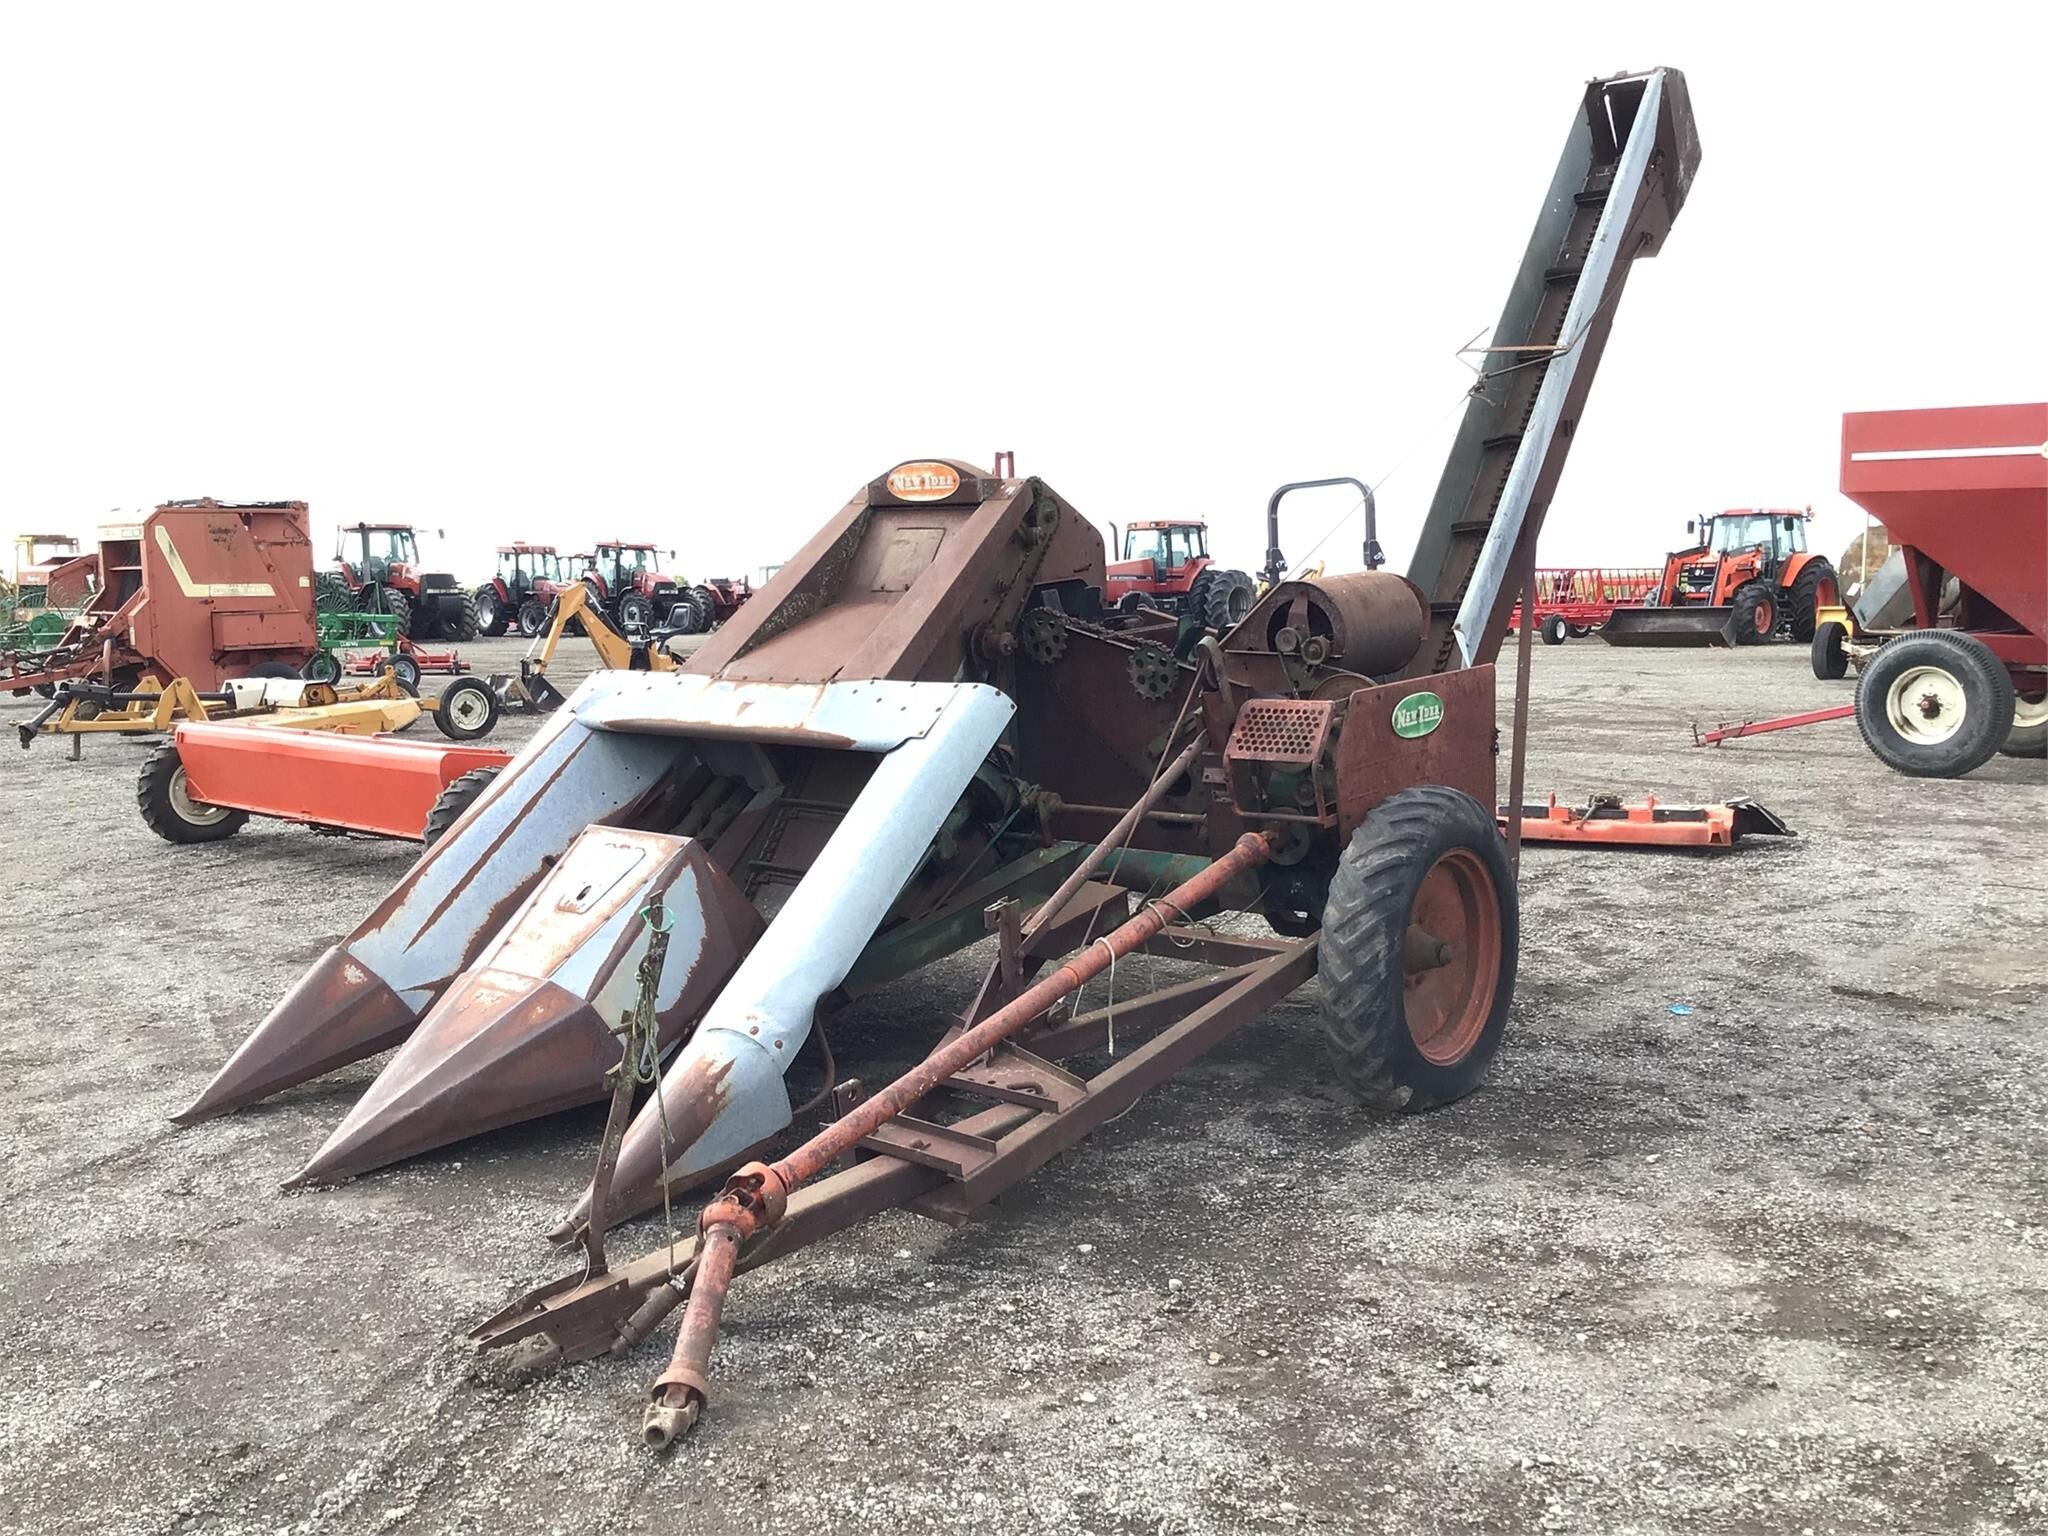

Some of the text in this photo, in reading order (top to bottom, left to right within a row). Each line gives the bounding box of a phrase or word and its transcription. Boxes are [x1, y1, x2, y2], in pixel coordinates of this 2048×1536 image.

[891, 472, 954, 490] NEW IDEA
[1397, 705, 1440, 729] NEW IDEA
